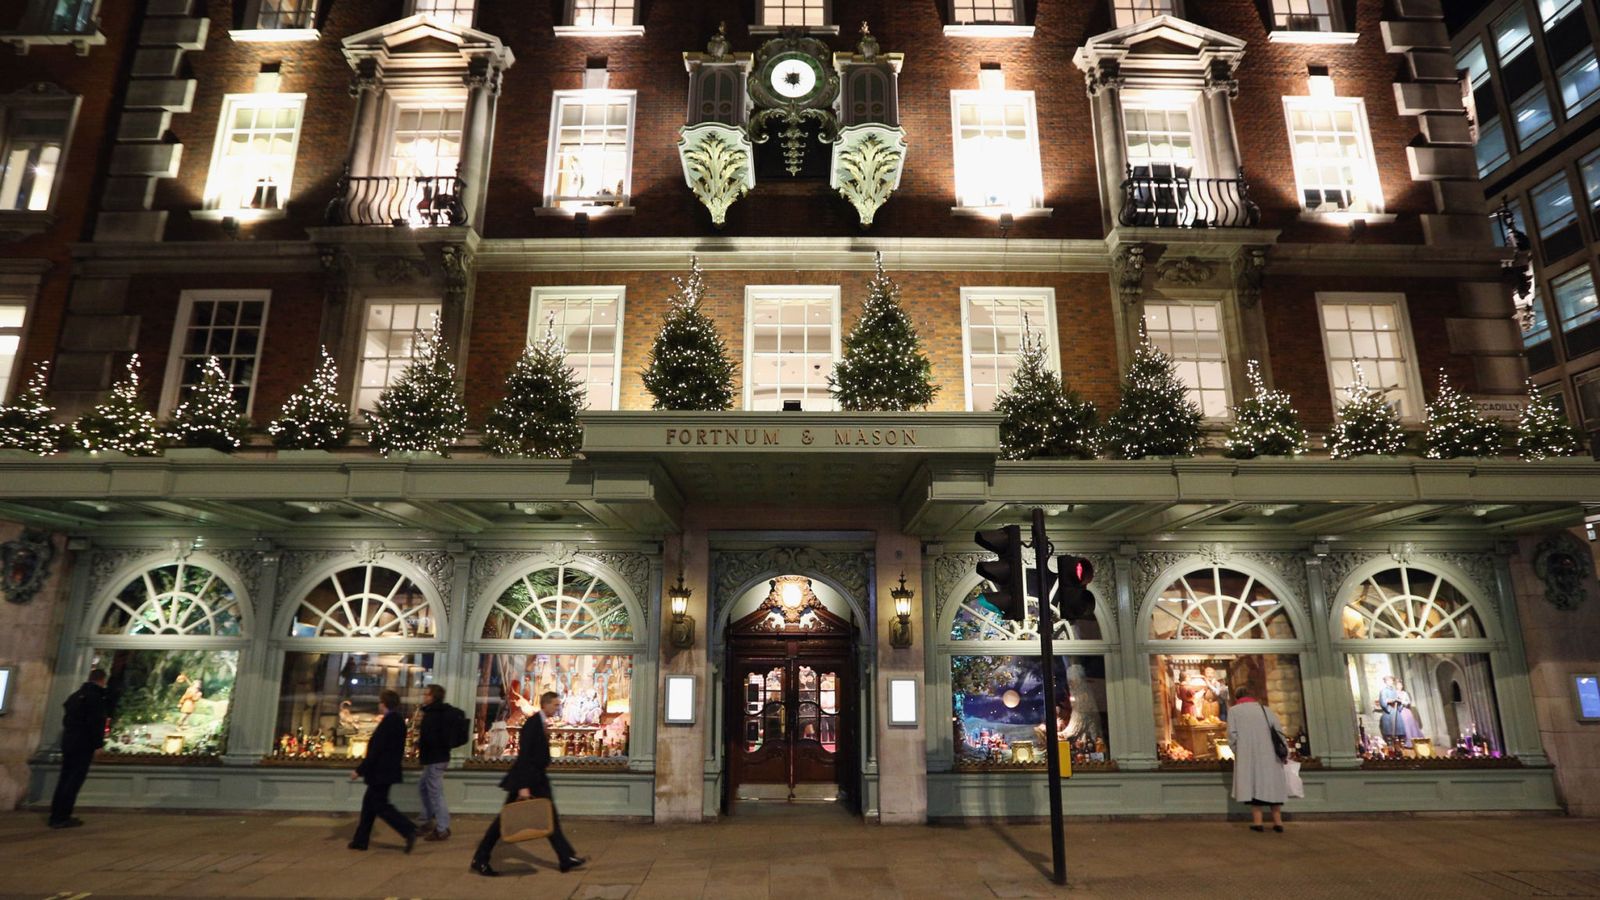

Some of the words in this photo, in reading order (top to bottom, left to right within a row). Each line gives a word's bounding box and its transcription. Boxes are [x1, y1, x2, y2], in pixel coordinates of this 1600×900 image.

[1476, 403, 1520, 411] CCADILLY
[666, 429, 780, 445] FORTNUM
[801, 429, 814, 445] &
[834, 429, 917, 446] MASON
